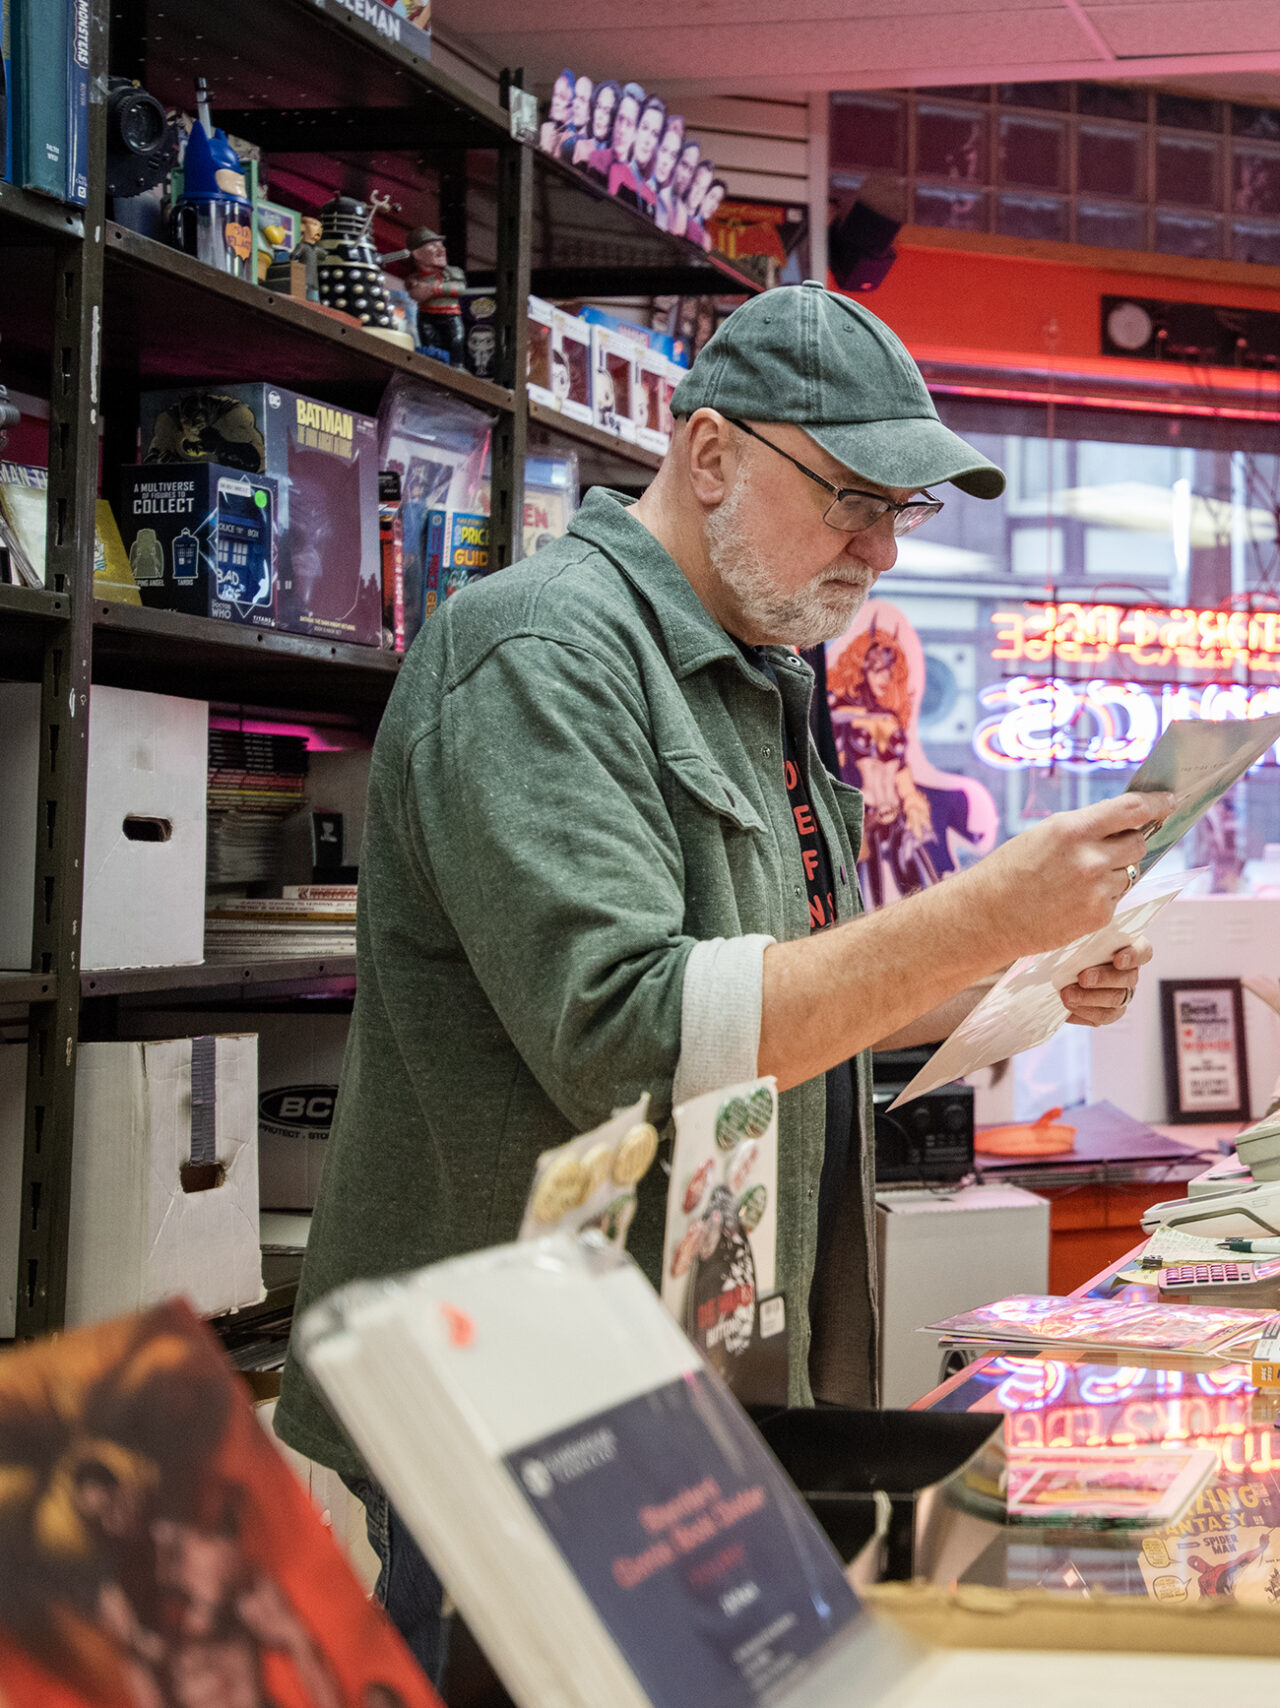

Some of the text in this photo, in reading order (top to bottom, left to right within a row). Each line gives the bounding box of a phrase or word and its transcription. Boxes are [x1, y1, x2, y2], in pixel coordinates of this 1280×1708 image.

[78, 0, 89, 64] MONSTERS
[296, 398, 352, 440] BATMAN
[133, 481, 195, 492] A MULTIVERSE
[133, 498, 195, 514] COLLECT
[524, 503, 549, 529] EN
[453, 548, 489, 567] GUID
[212, 608, 231, 620] WHO
[278, 1096, 333, 1118] BC
[1187, 1485, 1259, 1517] ZING
[1203, 1534, 1239, 1547] SPIDER
[1213, 1544, 1238, 1555] MAN
